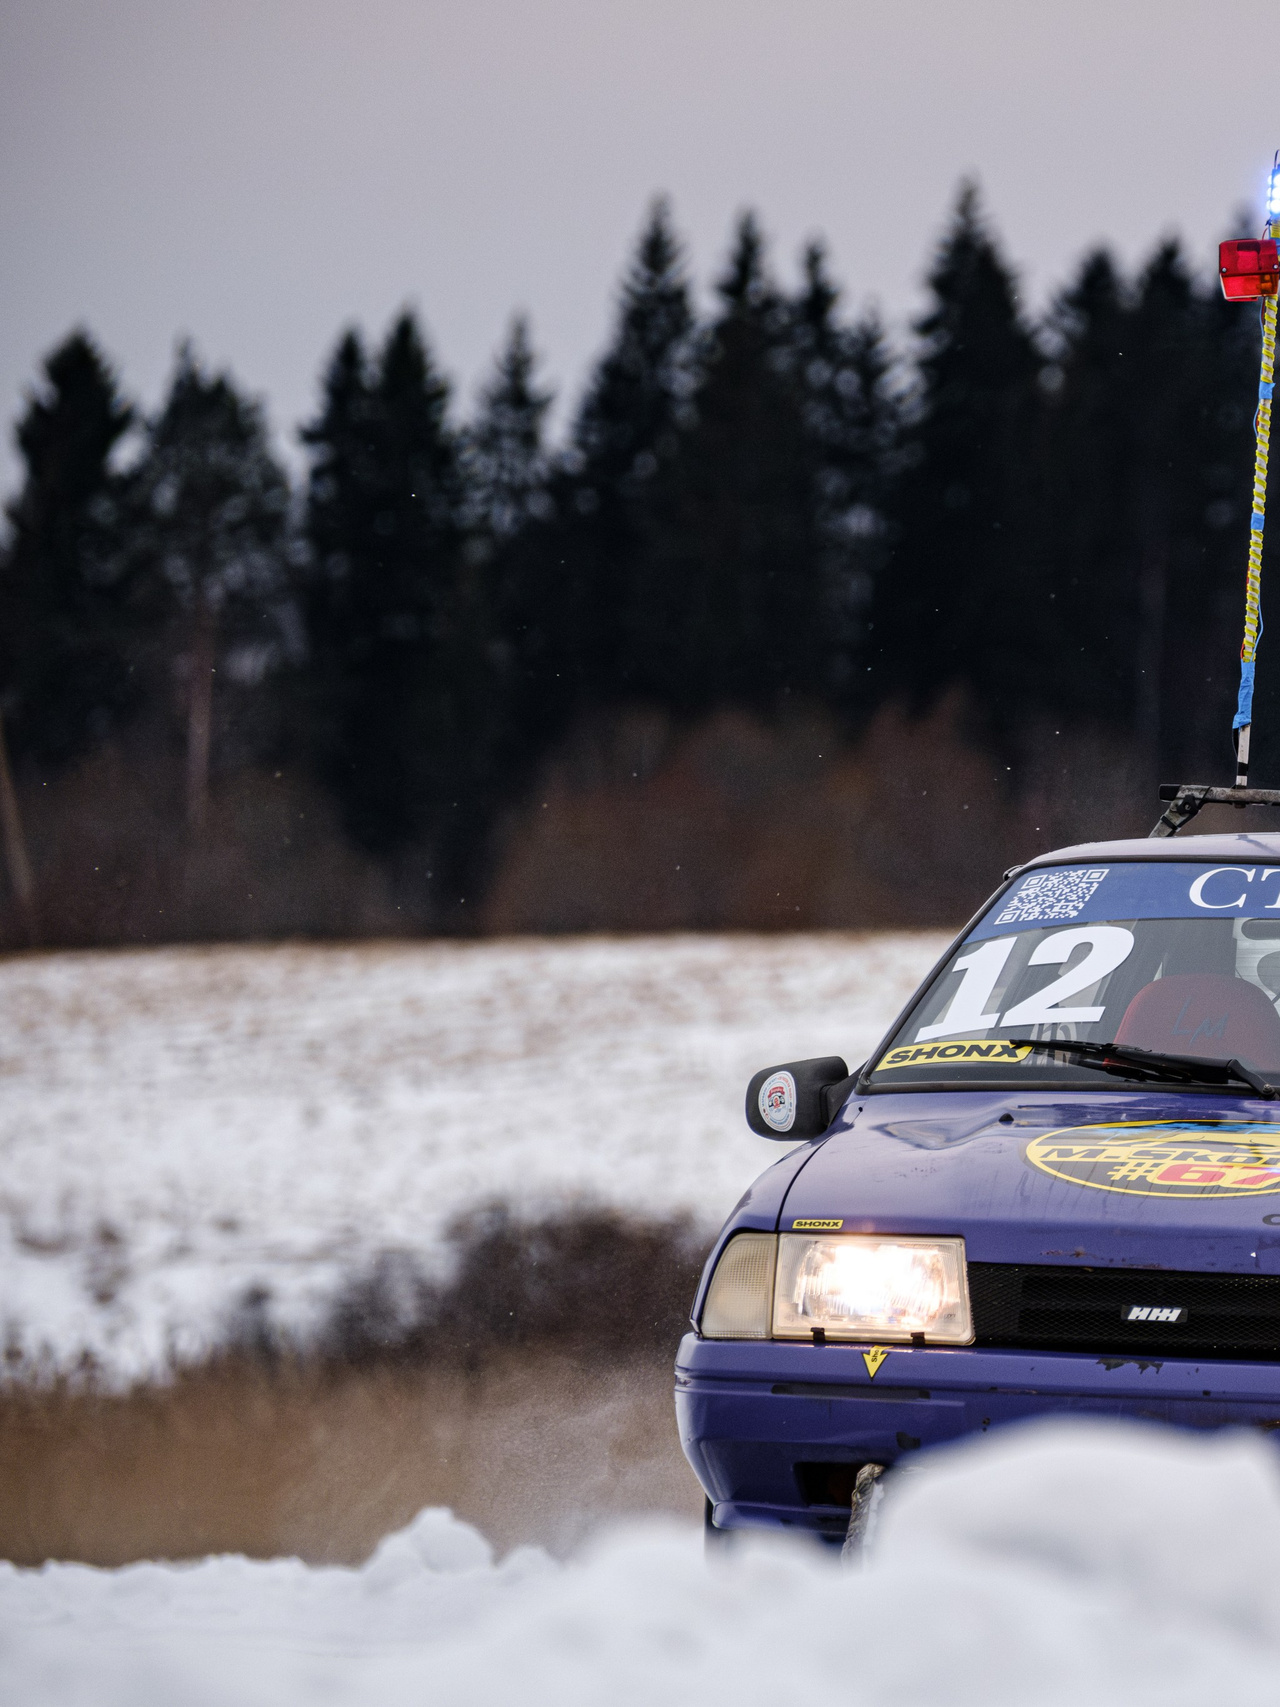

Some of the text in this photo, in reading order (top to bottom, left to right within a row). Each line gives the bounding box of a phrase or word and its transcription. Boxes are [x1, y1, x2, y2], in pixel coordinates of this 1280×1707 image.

[914, 926, 1135, 1043] 12
[890, 1042, 1022, 1062] SHONX
[795, 1220, 841, 1229] SHONX
